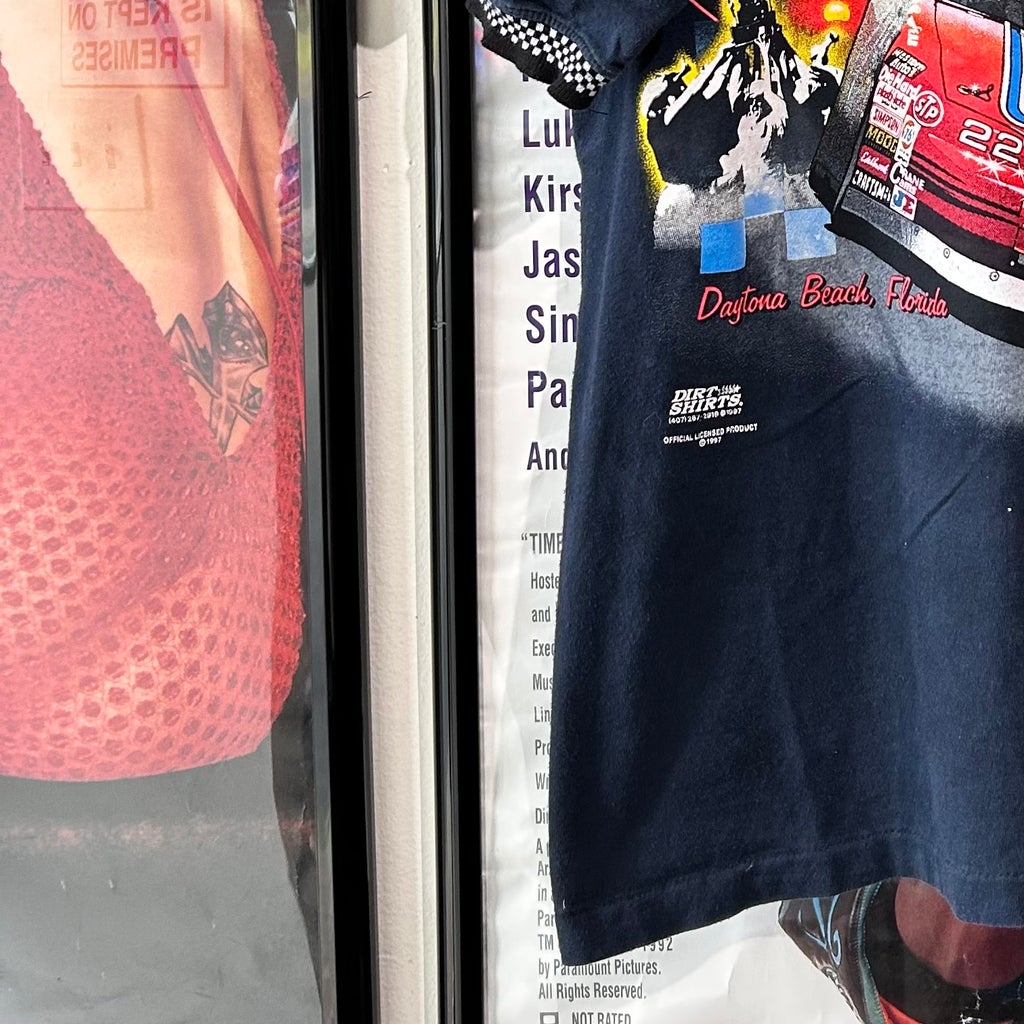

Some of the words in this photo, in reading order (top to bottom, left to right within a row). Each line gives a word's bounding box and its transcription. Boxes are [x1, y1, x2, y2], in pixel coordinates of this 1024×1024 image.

[914, 95, 940, 120] STP
[958, 118, 1024, 164] 22
[524, 240, 580, 278] Jas
[697, 286, 788, 325] Daytona
[801, 273, 876, 310] Beach,
[885, 275, 950, 318] Florida
[527, 370, 568, 409] Pa
[671, 385, 719, 403] DIRT
[663, 434, 693, 445] OFFICIAL
[694, 428, 725, 441] LICENSED
[726, 423, 758, 434] PRODUCT
[531, 606, 551, 623] and
[538, 934, 554, 951] TM
[539, 958, 550, 979] by
[614, 958, 662, 976] Pictures.
[538, 982, 553, 999] All
[556, 982, 590, 1002] Rights
[594, 982, 647, 999] Reserved.
[572, 1011, 594, 1024] NOT
[597, 1013, 631, 1024] RATED
